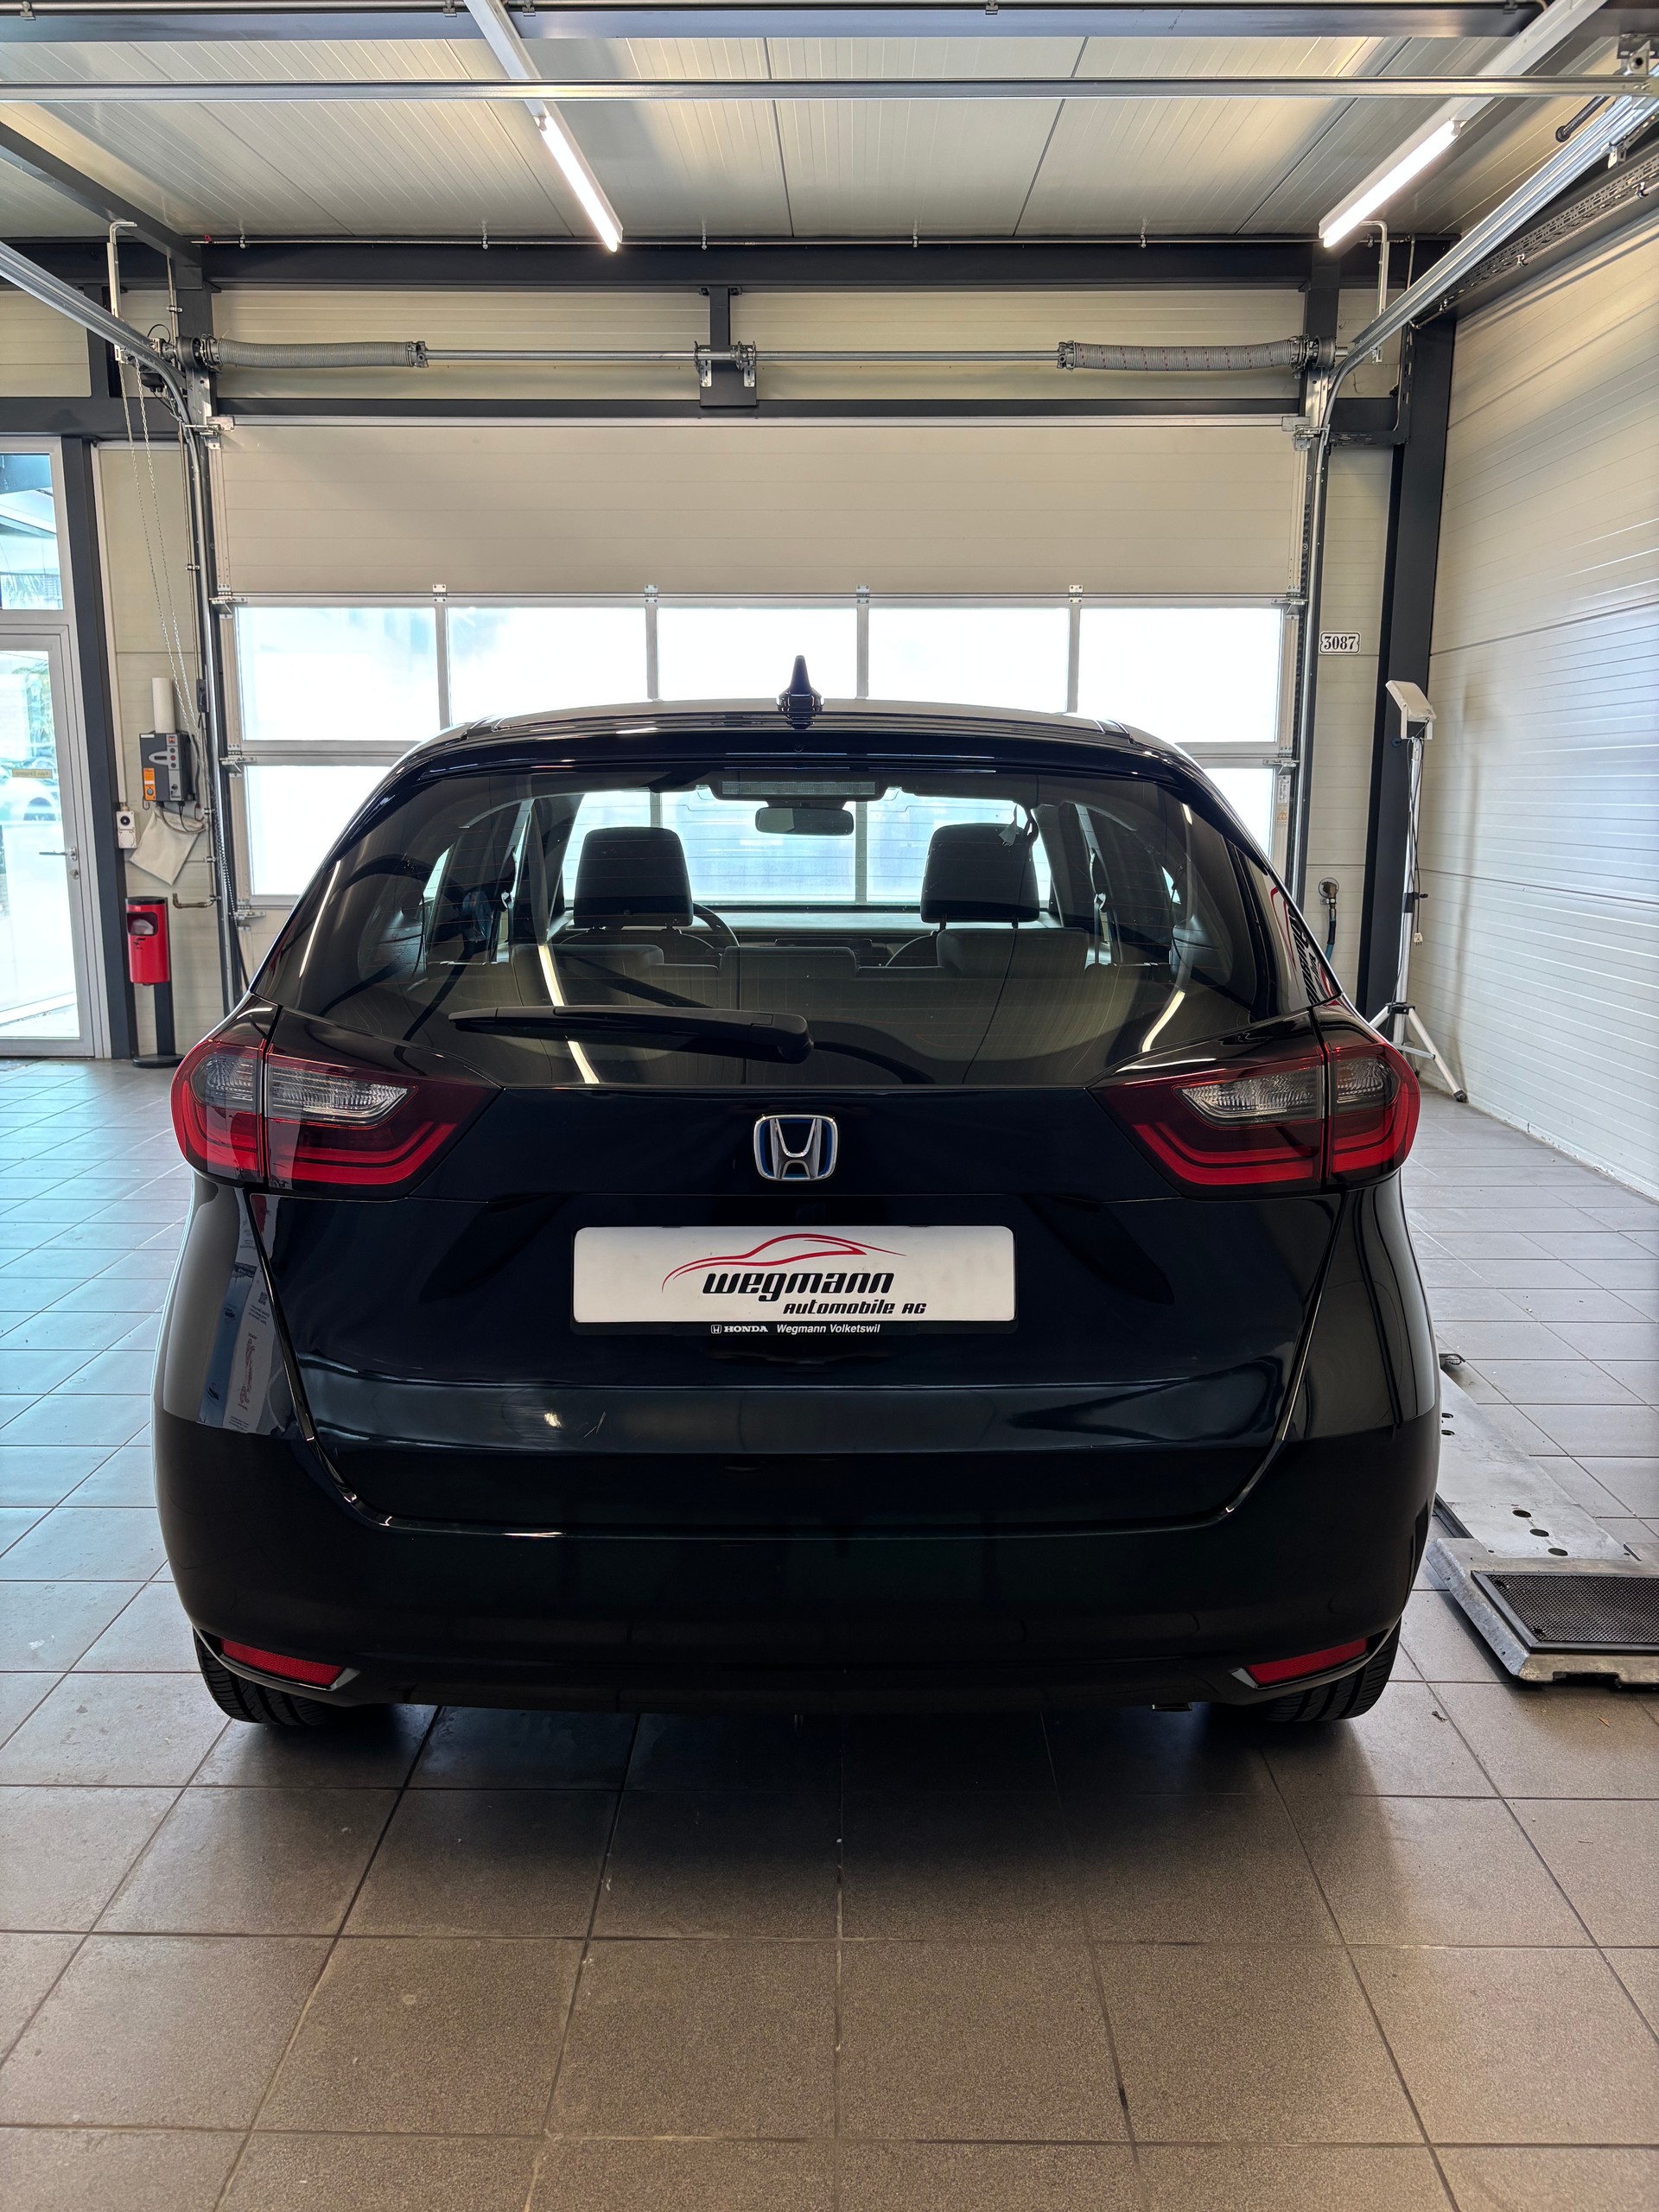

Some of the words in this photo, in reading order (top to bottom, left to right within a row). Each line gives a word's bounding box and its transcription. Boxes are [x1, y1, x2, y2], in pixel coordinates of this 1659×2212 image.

[1324, 636, 1356, 650] 3087
[702, 1272, 894, 1302] wegmann
[783, 1300, 895, 1314] automobile
[902, 1303, 927, 1314] AG
[777, 1324, 827, 1336] Wegmann
[830, 1324, 880, 1333] Volketswil
